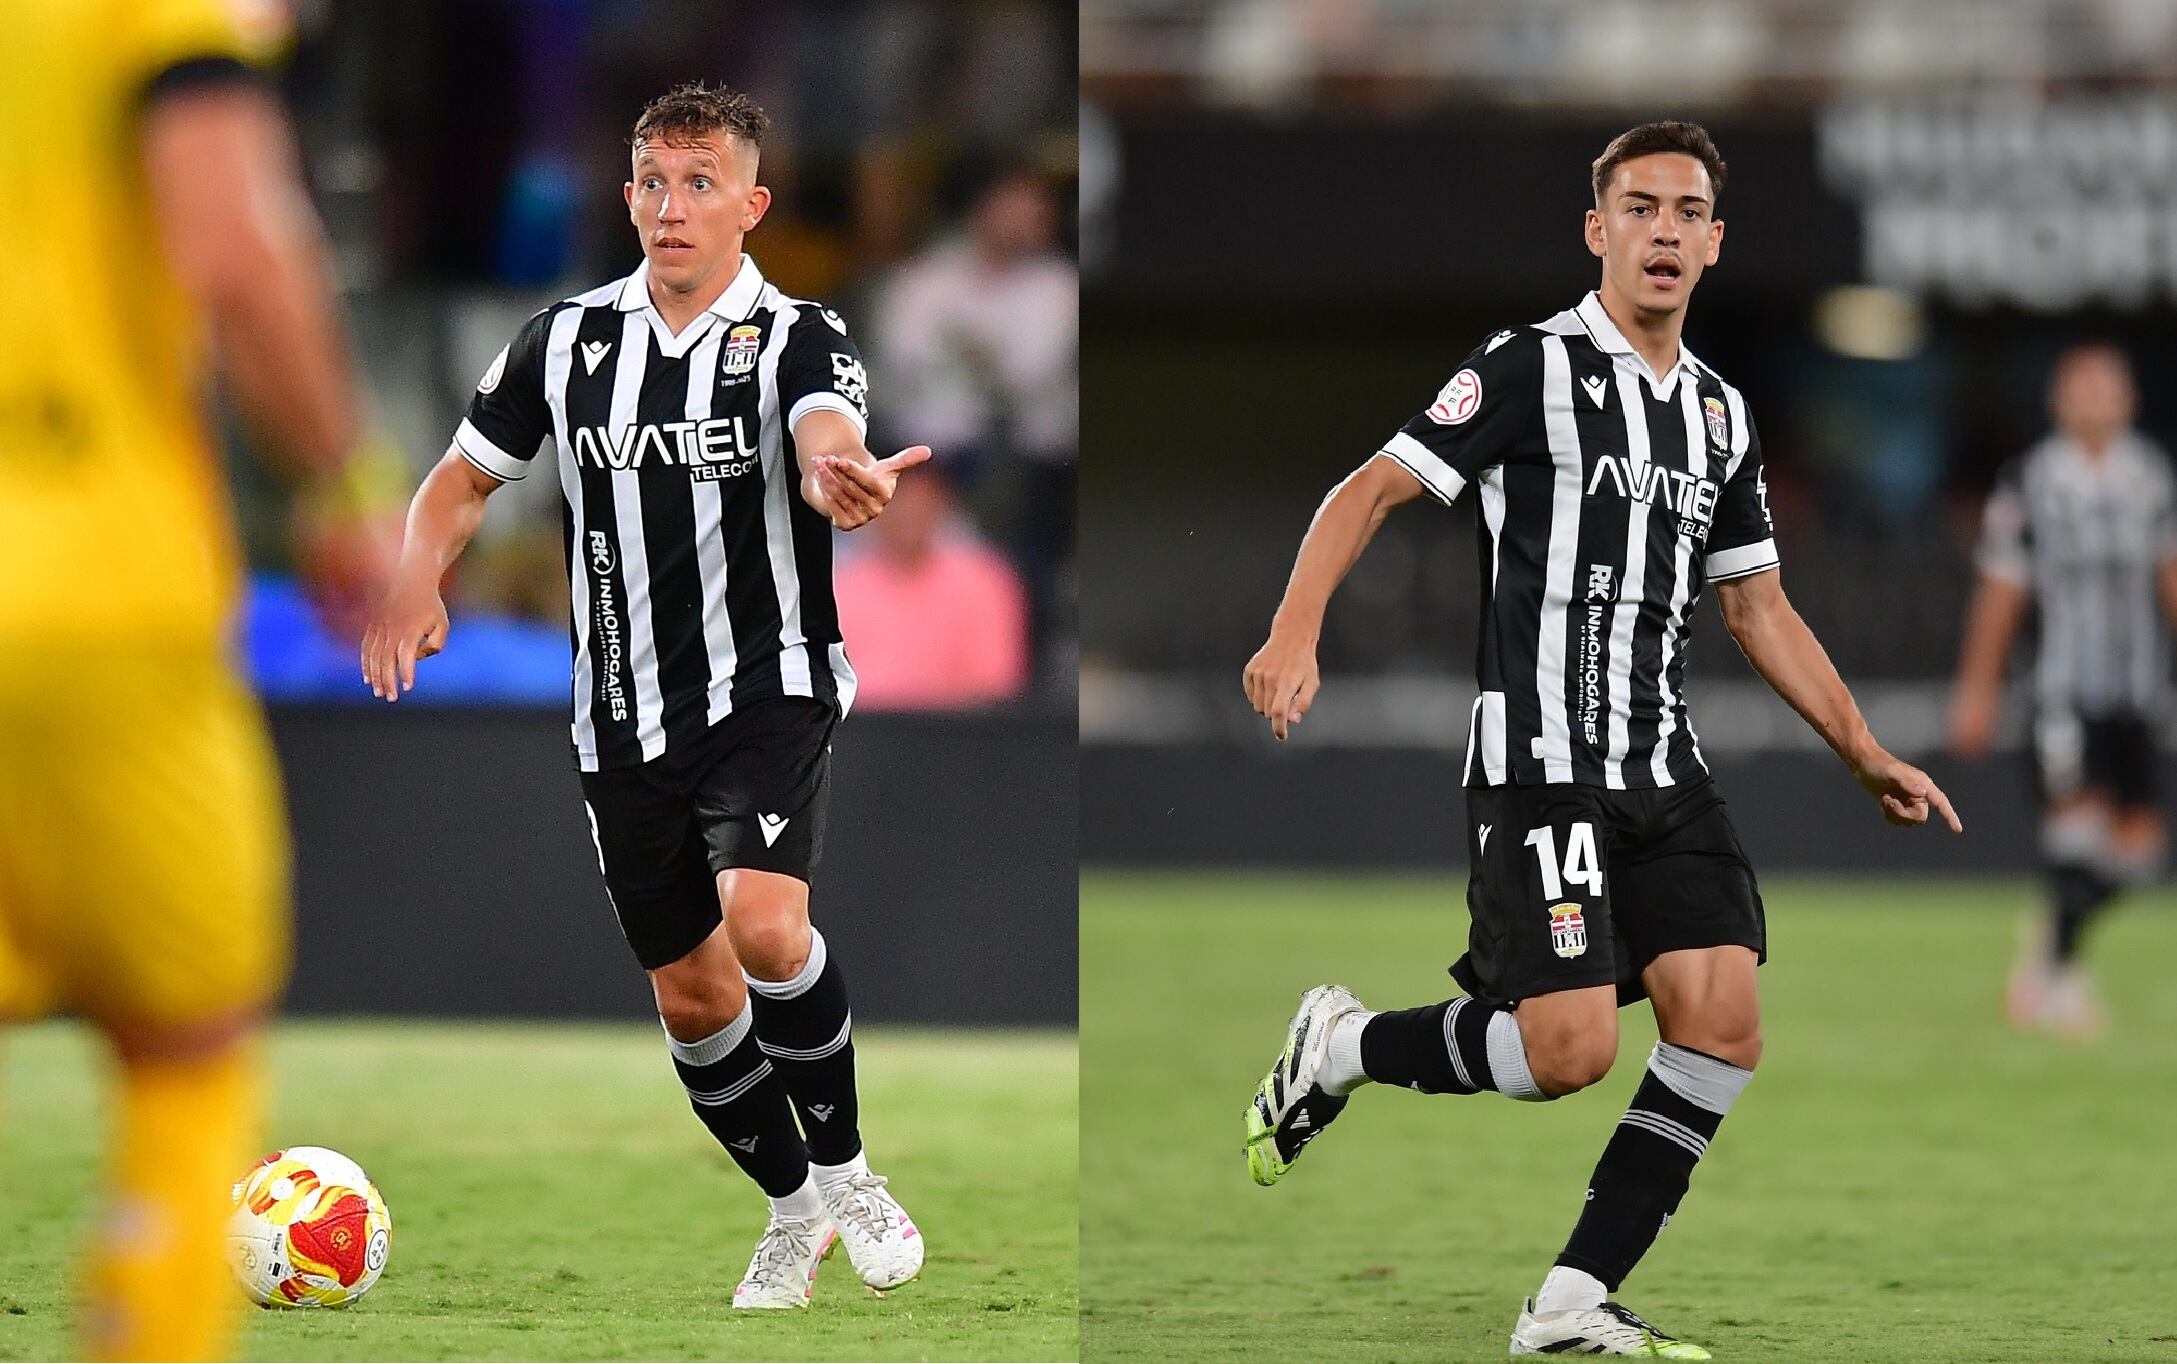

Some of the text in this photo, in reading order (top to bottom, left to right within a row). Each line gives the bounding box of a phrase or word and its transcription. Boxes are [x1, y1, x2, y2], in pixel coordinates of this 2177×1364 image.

[575, 416, 759, 469] AVATEL
[589, 530, 627, 721] RK INMOHOGARES
[1585, 563, 1613, 745] RK INMOHOGARES
[1524, 822, 1603, 901] 14
